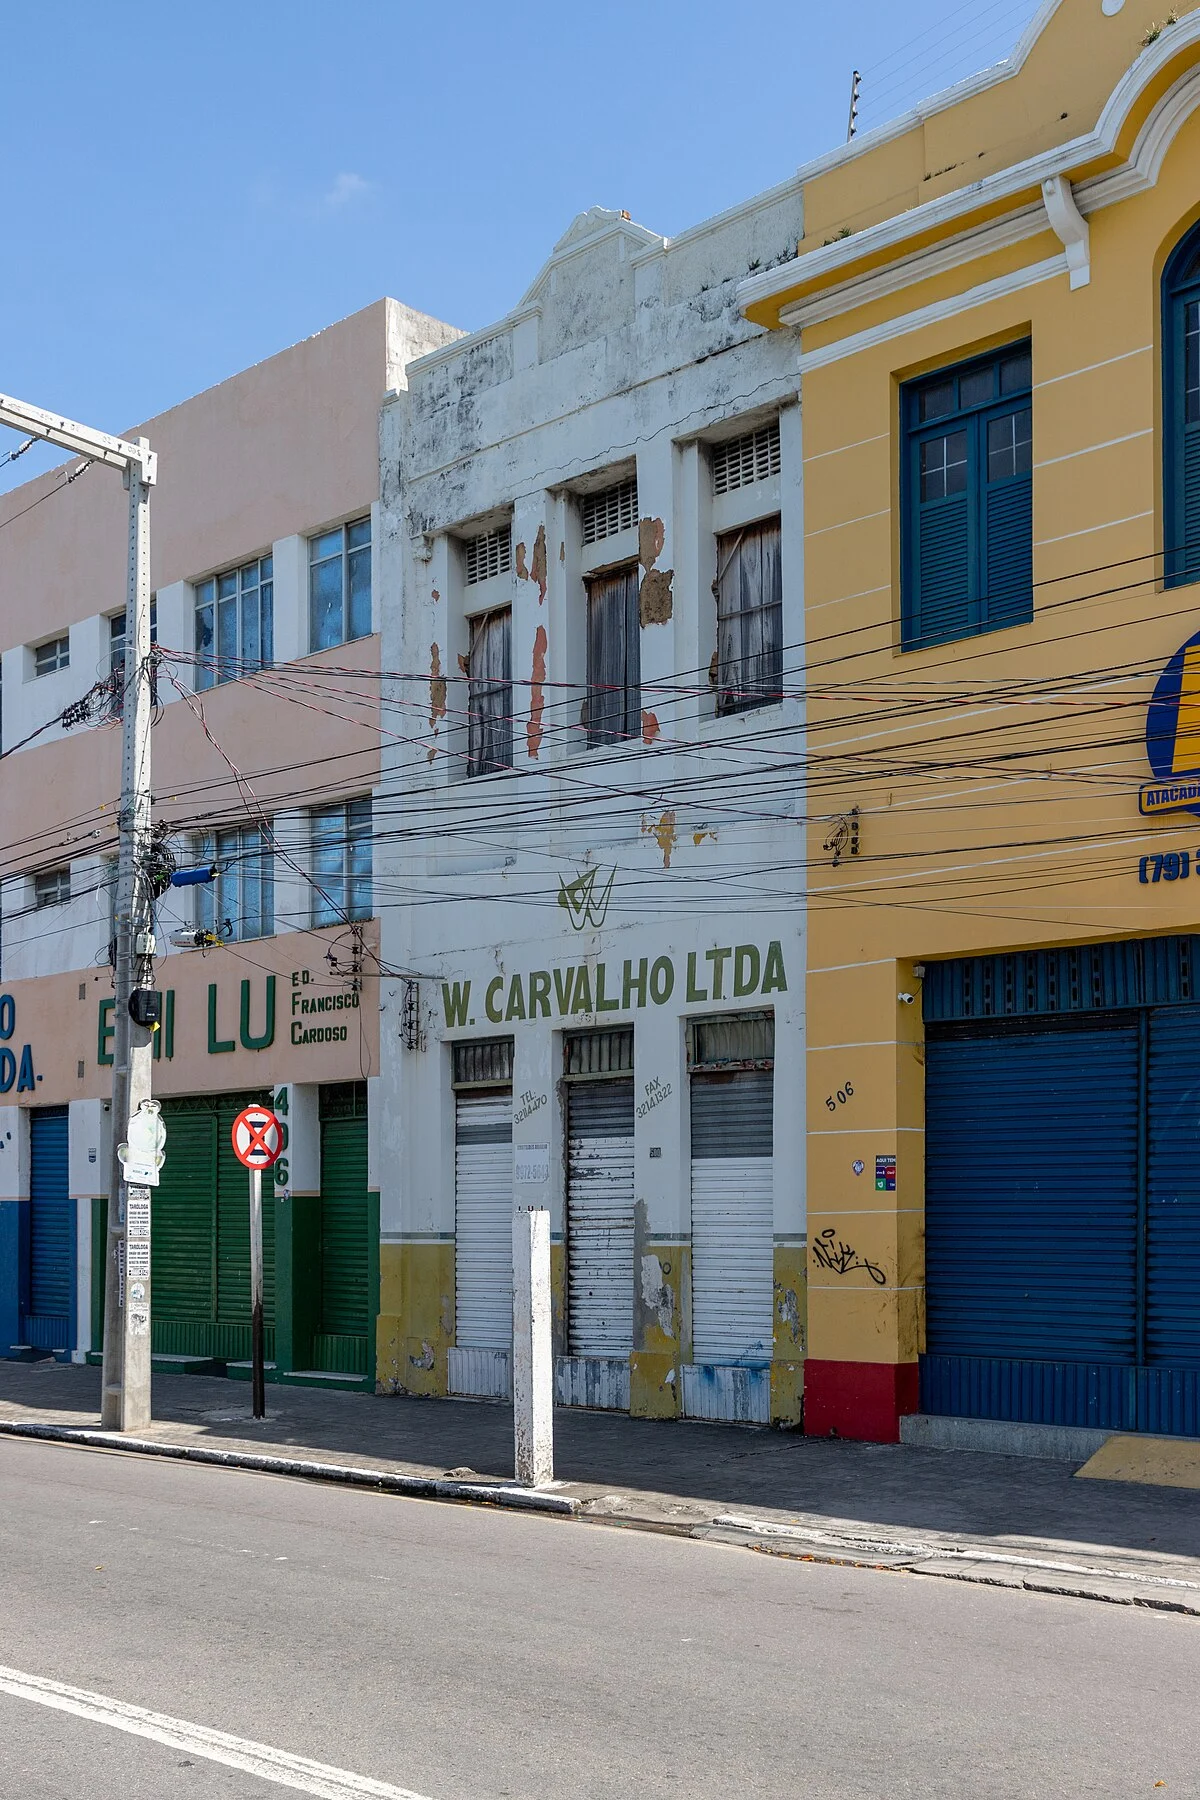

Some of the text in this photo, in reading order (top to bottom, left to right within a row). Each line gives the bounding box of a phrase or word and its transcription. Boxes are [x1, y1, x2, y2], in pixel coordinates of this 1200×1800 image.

[1146, 785, 1200, 806] ATACAD
[1139, 851, 1190, 884] (79)
[292, 970, 314, 987] ED.
[441, 940, 788, 1028] W. CARVALHO LTDA
[208, 975, 276, 1054] LU
[291, 992, 360, 1016] FRANCISCO
[291, 1021, 348, 1045] CARDOSO
[645, 1076, 661, 1096] FAX
[825, 1081, 854, 1112] 506
